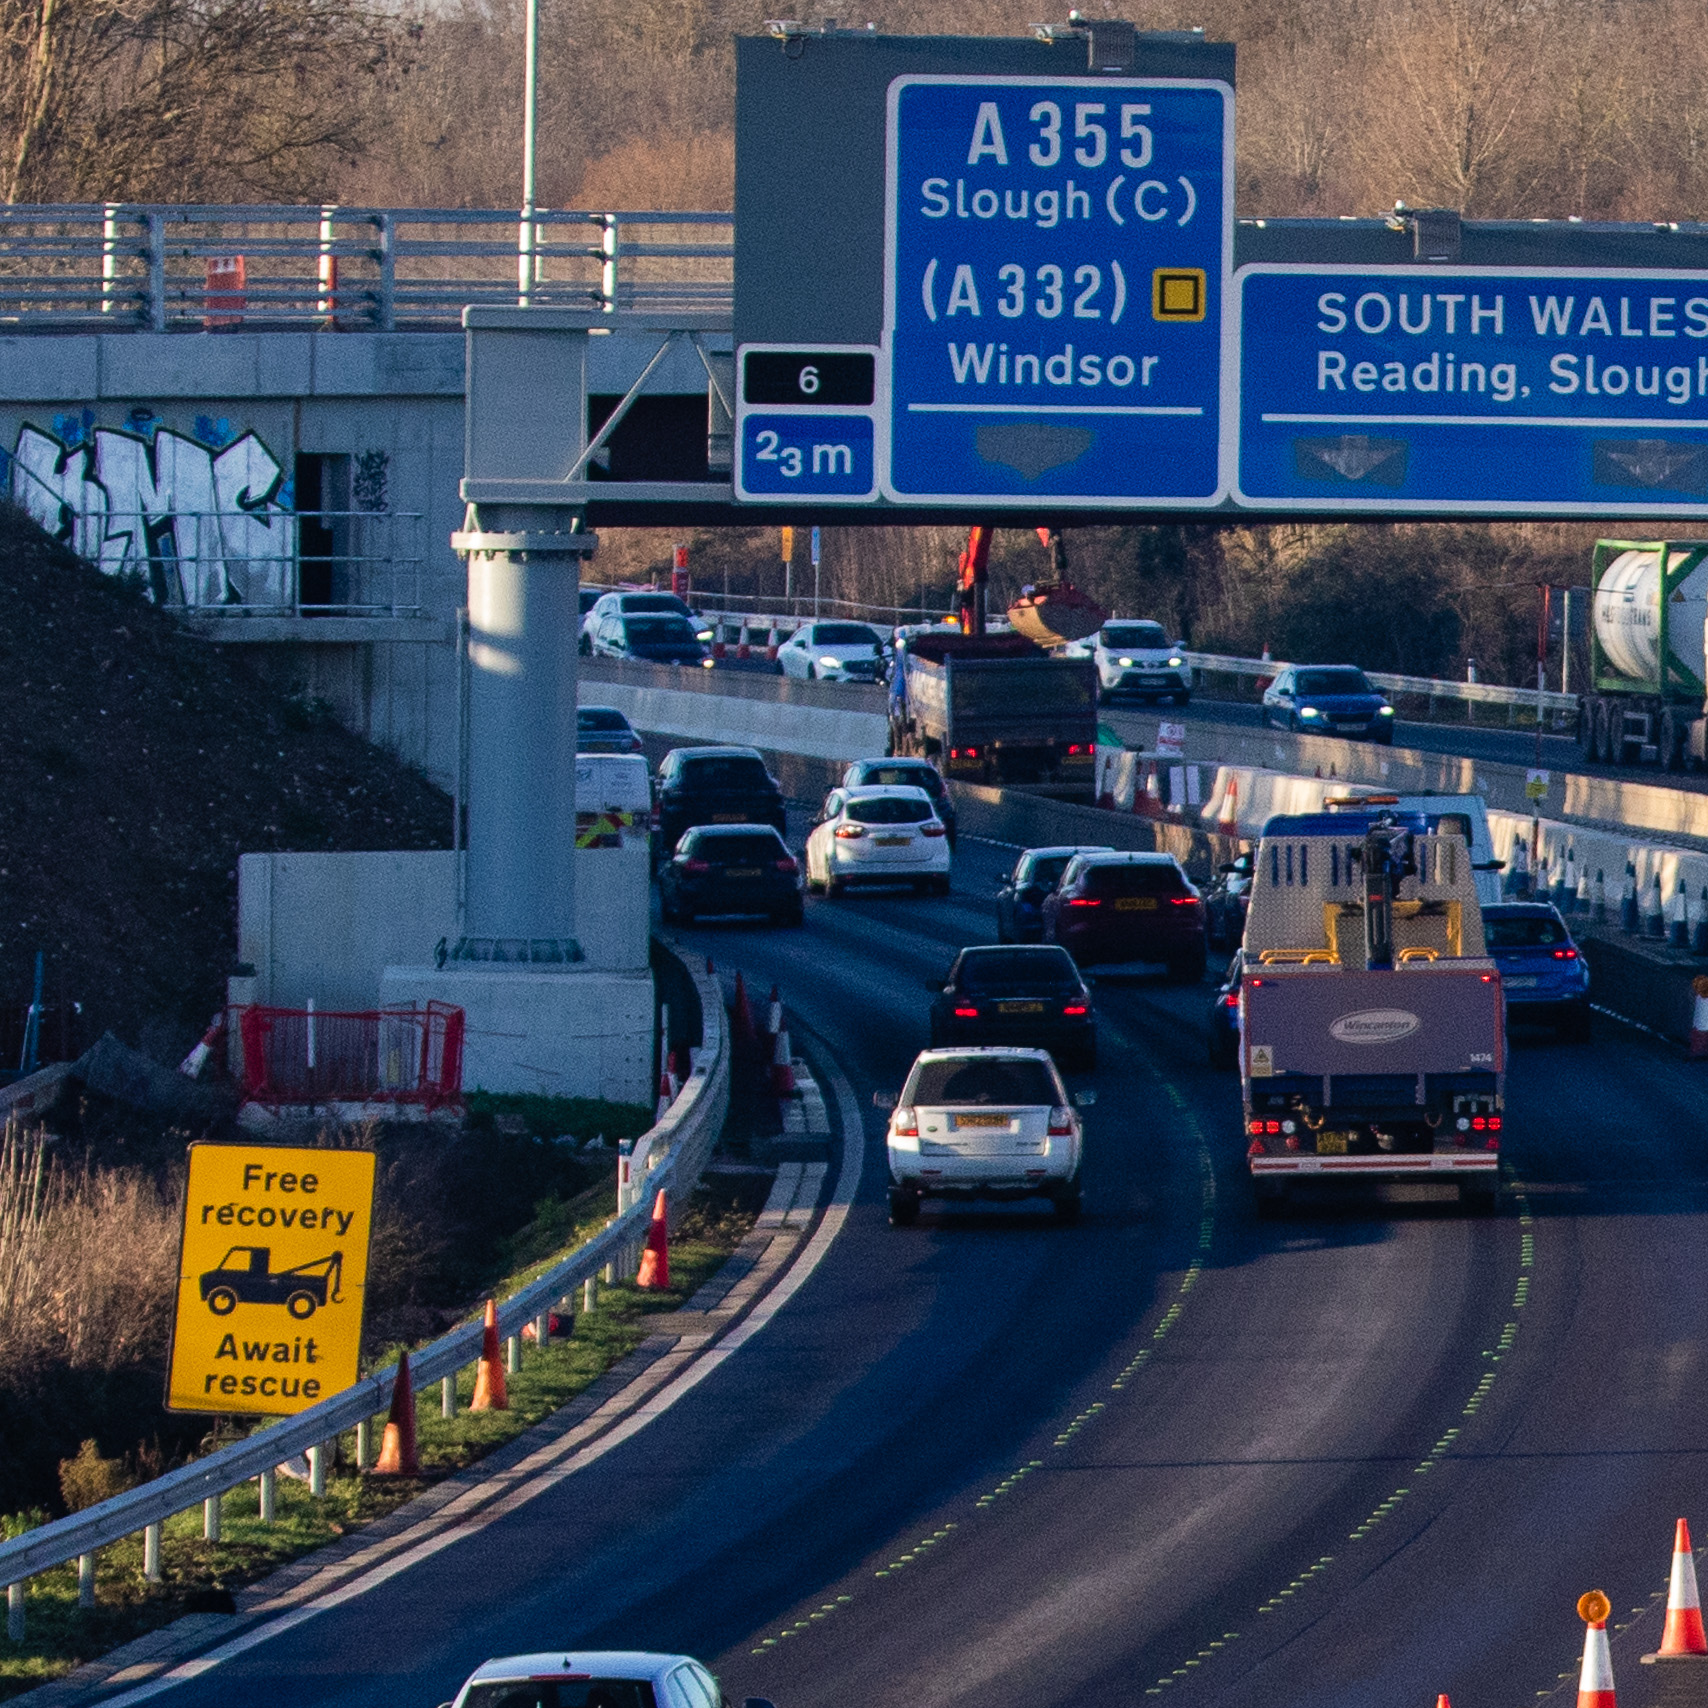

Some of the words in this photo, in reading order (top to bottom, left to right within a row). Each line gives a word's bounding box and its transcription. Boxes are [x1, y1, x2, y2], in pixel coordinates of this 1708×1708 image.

[967, 101, 1009, 166] A
[1028, 100, 1153, 168] 355
[920, 177, 1091, 228] Slough
[1105, 174, 1197, 227] (C)
[997, 258, 1127, 325] 332)
[1316, 291, 1504, 335] SOUTH
[798, 365, 820, 394] 6
[947, 341, 1159, 387] Windsor
[1316, 350, 1531, 402] Reading,
[812, 443, 852, 474] m
[1343, 1019, 1411, 1031] Wincanton
[242, 1163, 319, 1194] Free
[201, 1203, 355, 1236] recovery
[213, 1332, 319, 1364] Await
[203, 1372, 321, 1399] rescue
